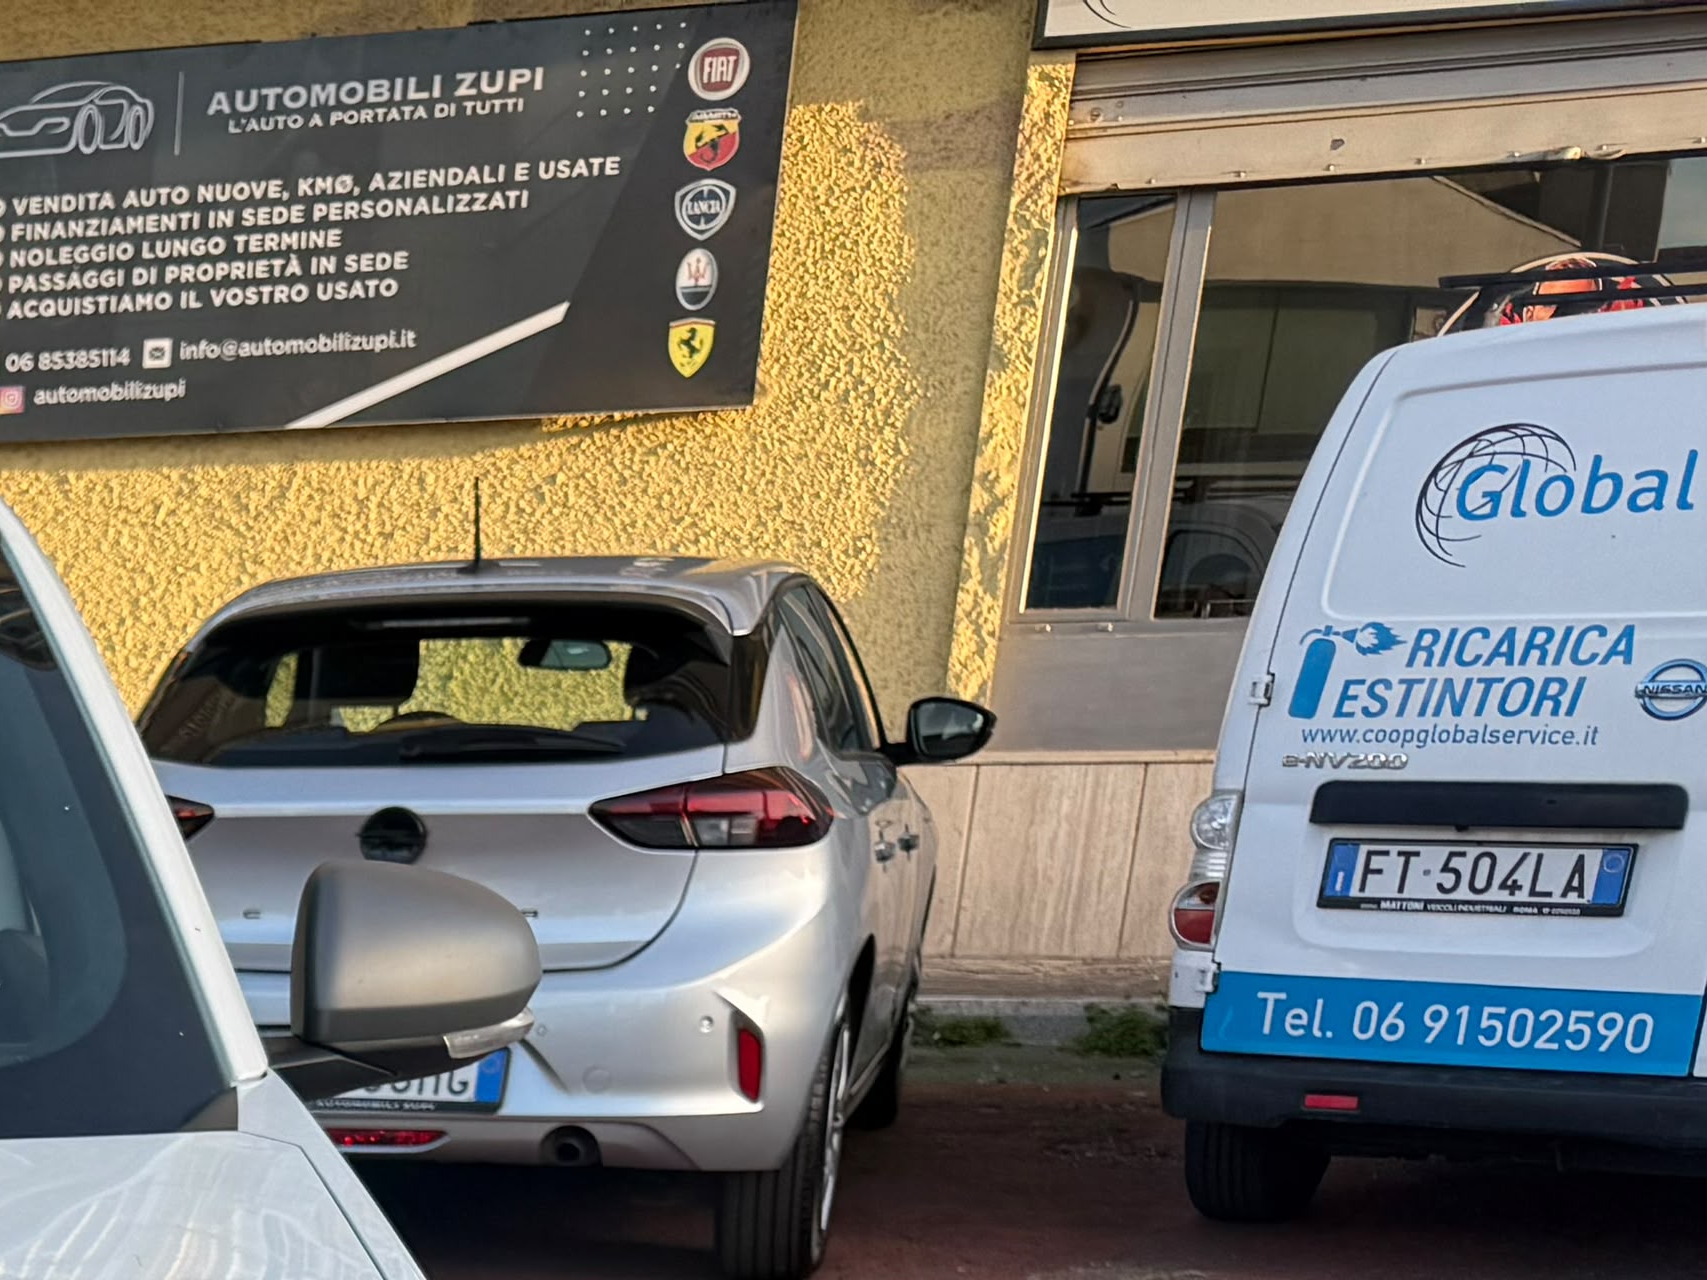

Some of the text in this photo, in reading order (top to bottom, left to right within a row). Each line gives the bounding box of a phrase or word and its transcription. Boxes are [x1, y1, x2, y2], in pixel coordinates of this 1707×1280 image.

[206, 66, 544, 116] AUTOMOBILI ZUPI
[702, 55, 737, 84] FIAT
[228, 98, 524, 134] L'AUTO A PORTATA DI TUTTI
[11, 190, 116, 217] VENDITA
[122, 185, 190, 209] AUTO
[196, 180, 290, 204] NUOVE,
[368, 163, 506, 192] AZIENDALI
[514, 162, 530, 182] E
[537, 156, 621, 180] USATE
[10, 189, 529, 242] FINANZIAMENTI IN SEDE PERSONALIZZATI
[9, 228, 343, 269] NOLEGGIO LUNGO TERMINE
[7, 250, 410, 295] PASSAGGI DI PROPRIETÀ IN SEDE
[5, 277, 399, 321] ACQUISTIAMO IL VOSTRO USATO
[5, 352, 34, 373] 06
[1455, 448, 1699, 522] Global
[1405, 624, 1635, 668] RICARICA
[1332, 676, 1587, 718] ESTINTORI
[1643, 683, 1707, 695] NISSAN
[1302, 724, 1598, 749] www.coopglobalservice.it
[1257, 991, 1655, 1054] Tel. 06 91502590
